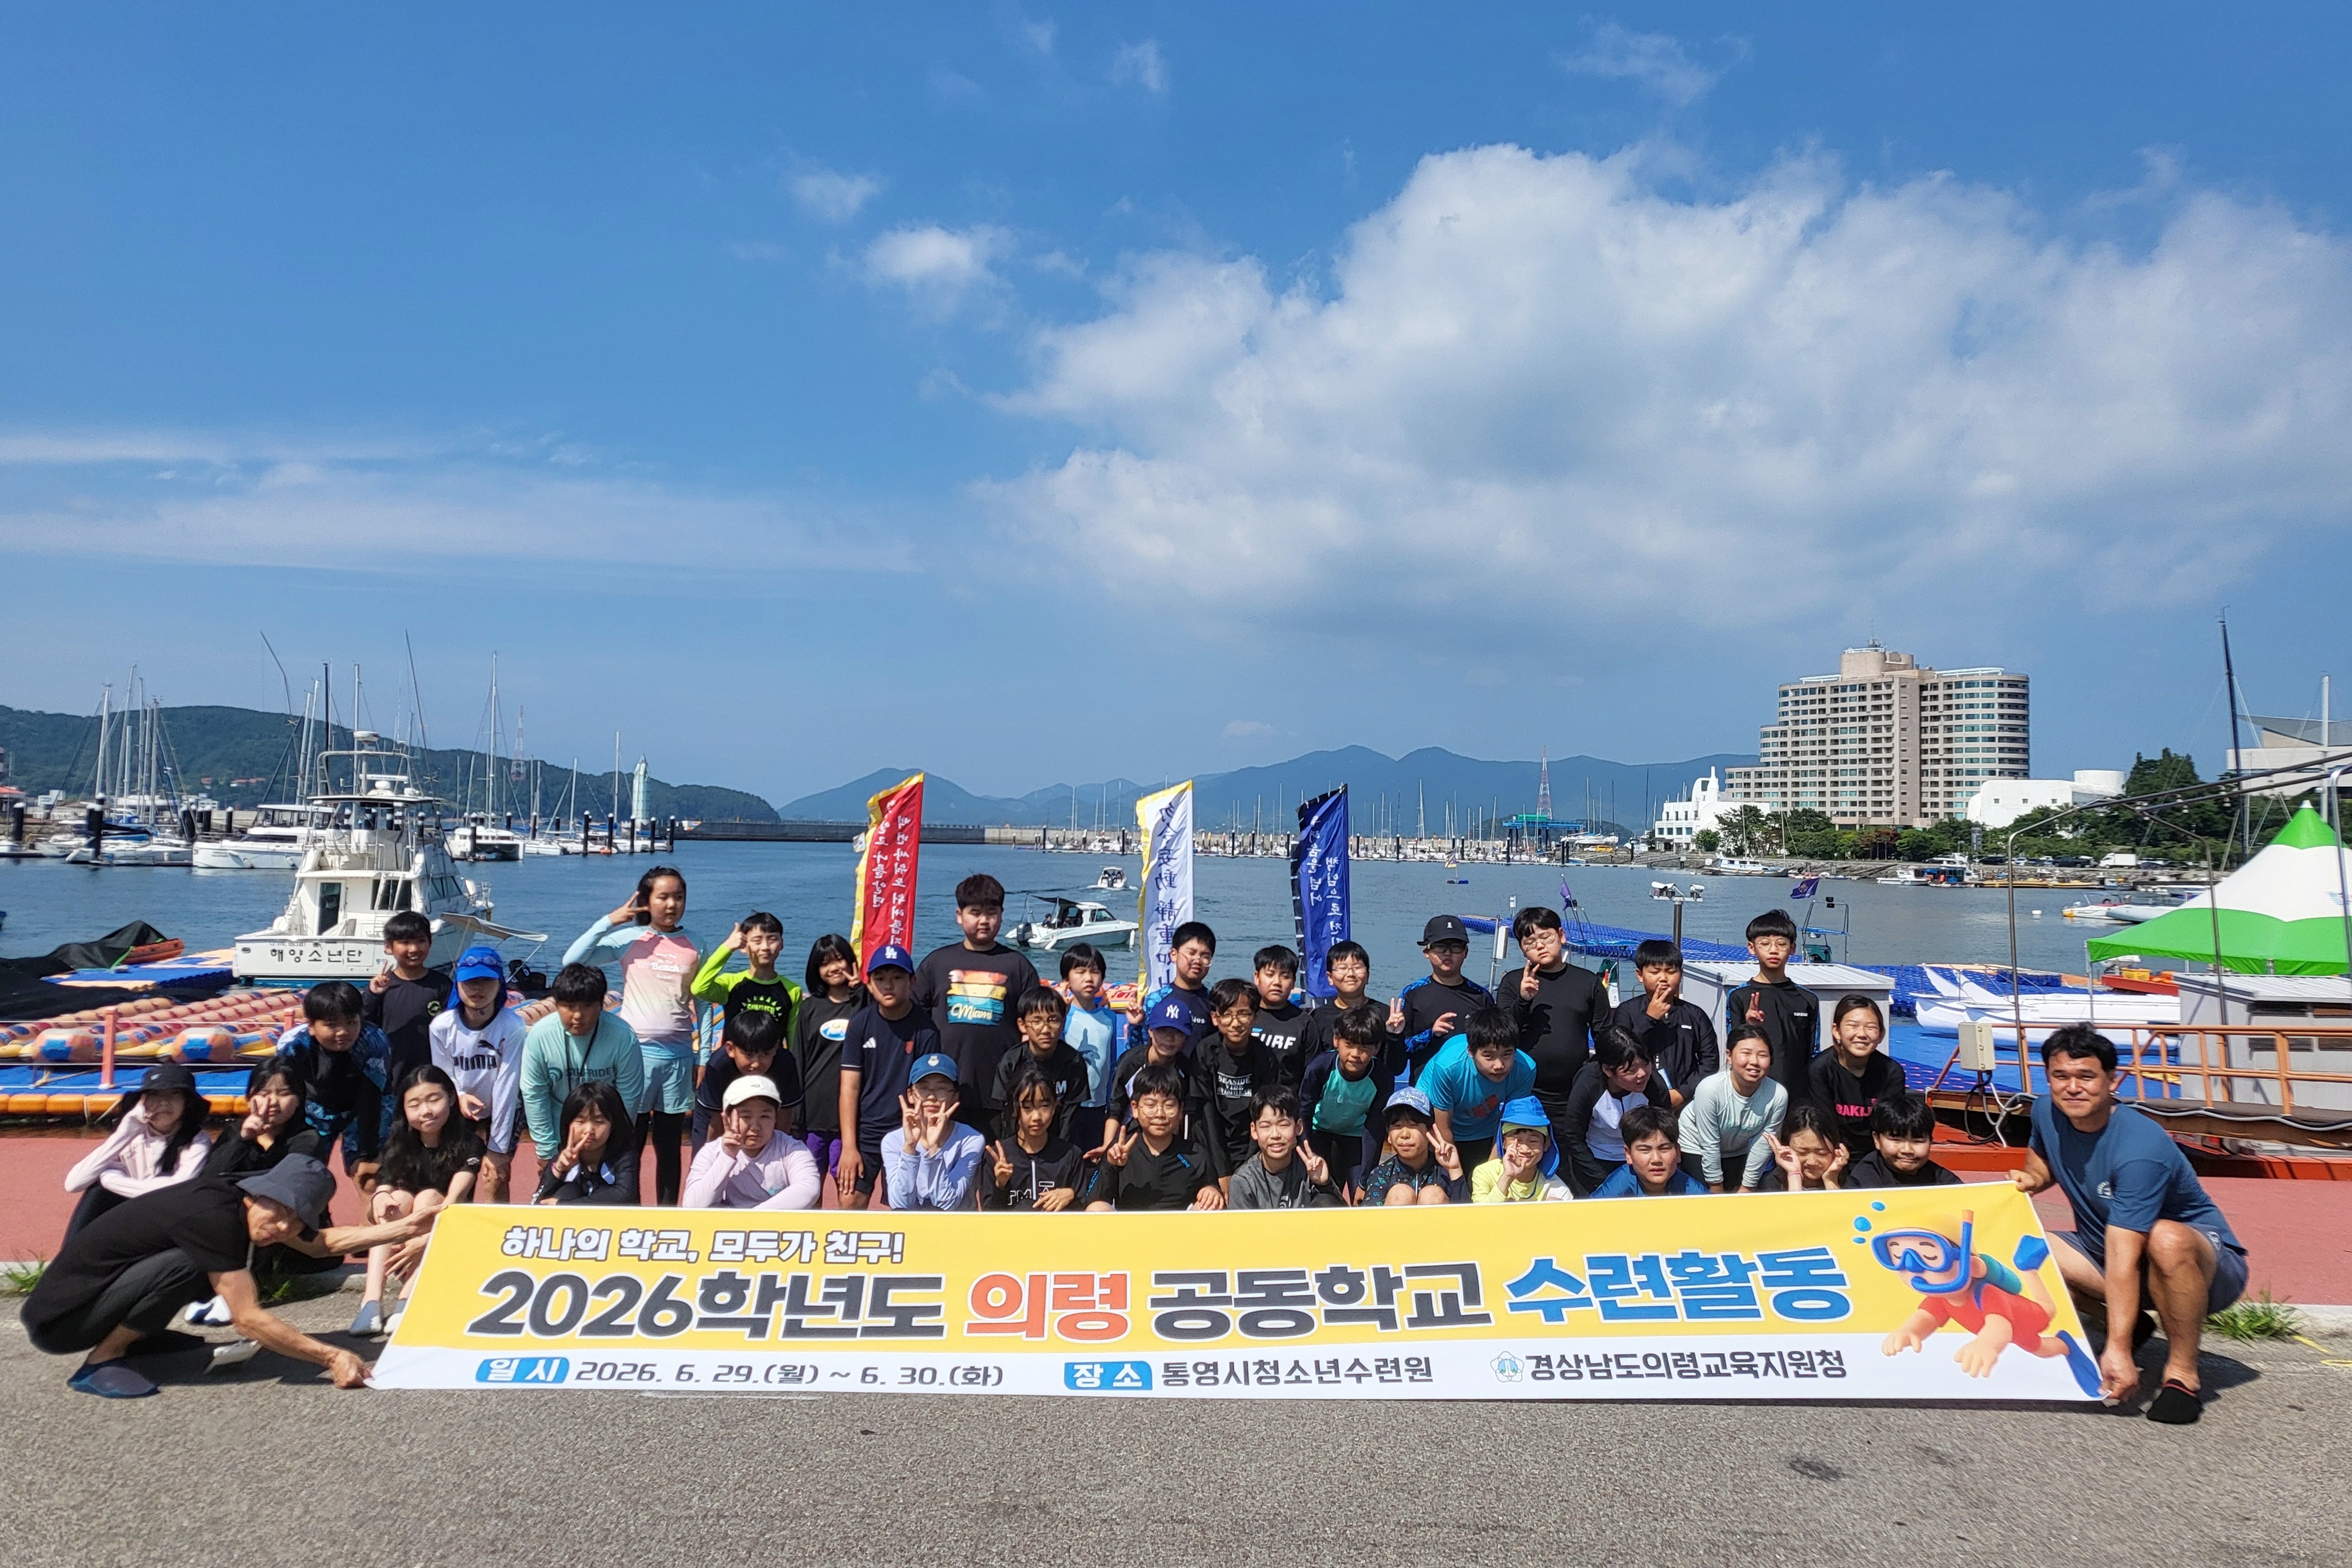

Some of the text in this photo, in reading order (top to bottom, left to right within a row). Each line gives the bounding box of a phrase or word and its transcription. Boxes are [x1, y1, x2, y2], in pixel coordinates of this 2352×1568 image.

[270, 948, 362, 963] 해양소년단
[885, 946, 897, 959] LA
[650, 962, 680, 972] Beach
[950, 1003, 993, 1019] Miami
[1166, 1004, 1180, 1019] NY
[1218, 1075, 1251, 1085] SEASIDE
[500, 1226, 905, 1264] 하나의 학교, 모두가 친구!
[468, 1247, 1852, 1341] 2026학년도 의령 공동학교 수련활동
[1161, 1357, 1434, 1386] 통영시청소년수련원
[1525, 1349, 1847, 1380] 경상남도의령교육지원청
[575, 1362, 663, 1383] 2026.
[674, 1364, 701, 1383] 6.
[711, 1363, 818, 1385] 29.(월)
[860, 1366, 886, 1385] 6.
[897, 1366, 1003, 1387] 30.(화)
